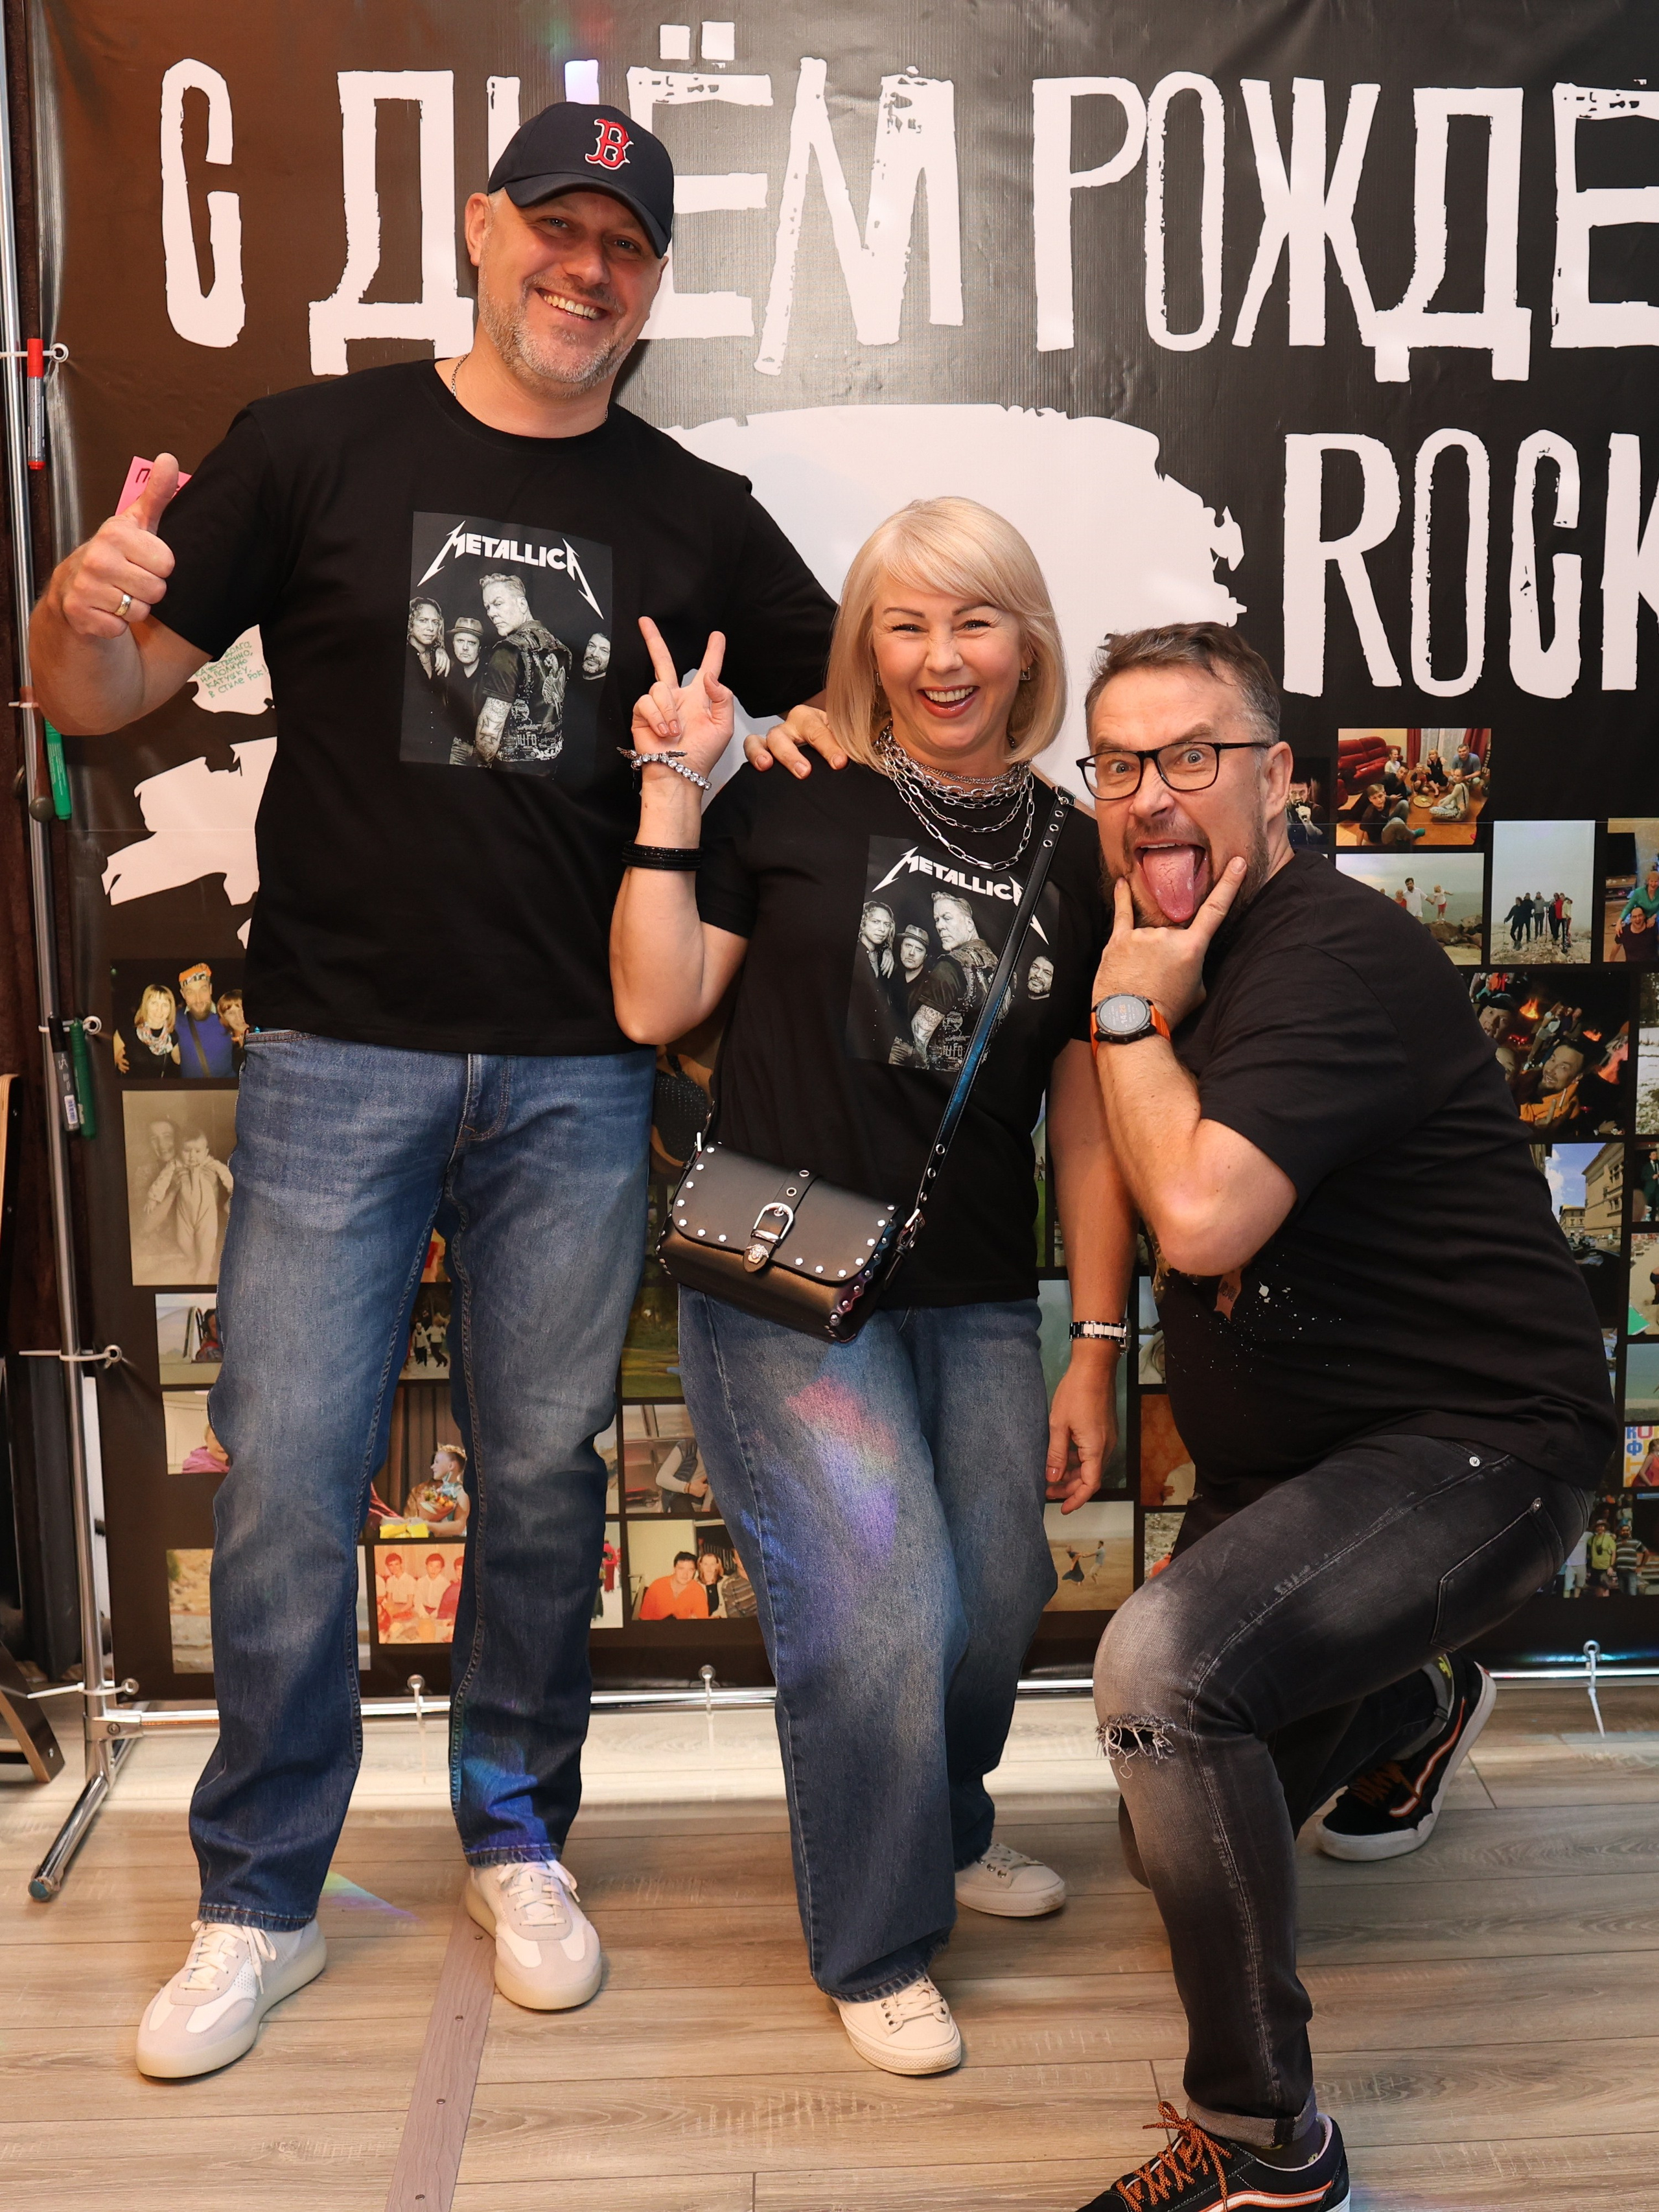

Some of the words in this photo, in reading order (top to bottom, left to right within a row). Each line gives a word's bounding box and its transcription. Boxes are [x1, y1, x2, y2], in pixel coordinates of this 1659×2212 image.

[585, 118, 634, 170] B
[160, 58, 246, 348] С
[1032, 71, 1659, 382] РОЖДЕ
[417, 520, 604, 620] METALLICA
